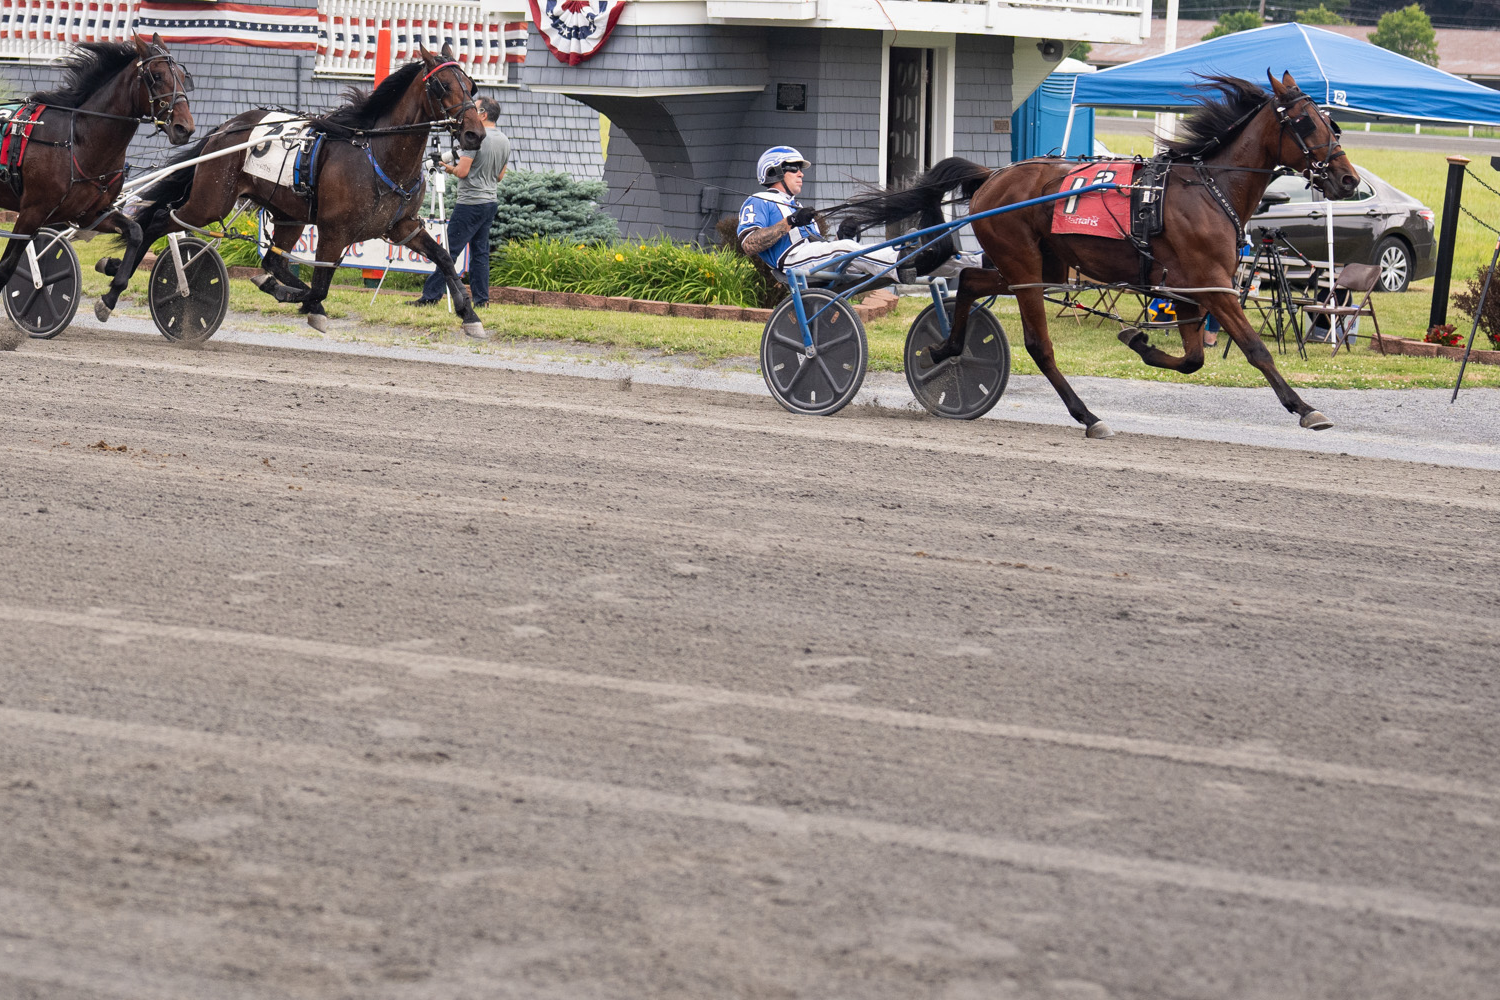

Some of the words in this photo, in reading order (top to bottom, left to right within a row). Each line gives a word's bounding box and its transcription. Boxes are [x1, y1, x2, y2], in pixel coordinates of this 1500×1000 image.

[1065, 177, 1086, 214] 1
[1091, 171, 1114, 192] 2
[741, 204, 756, 225] G
